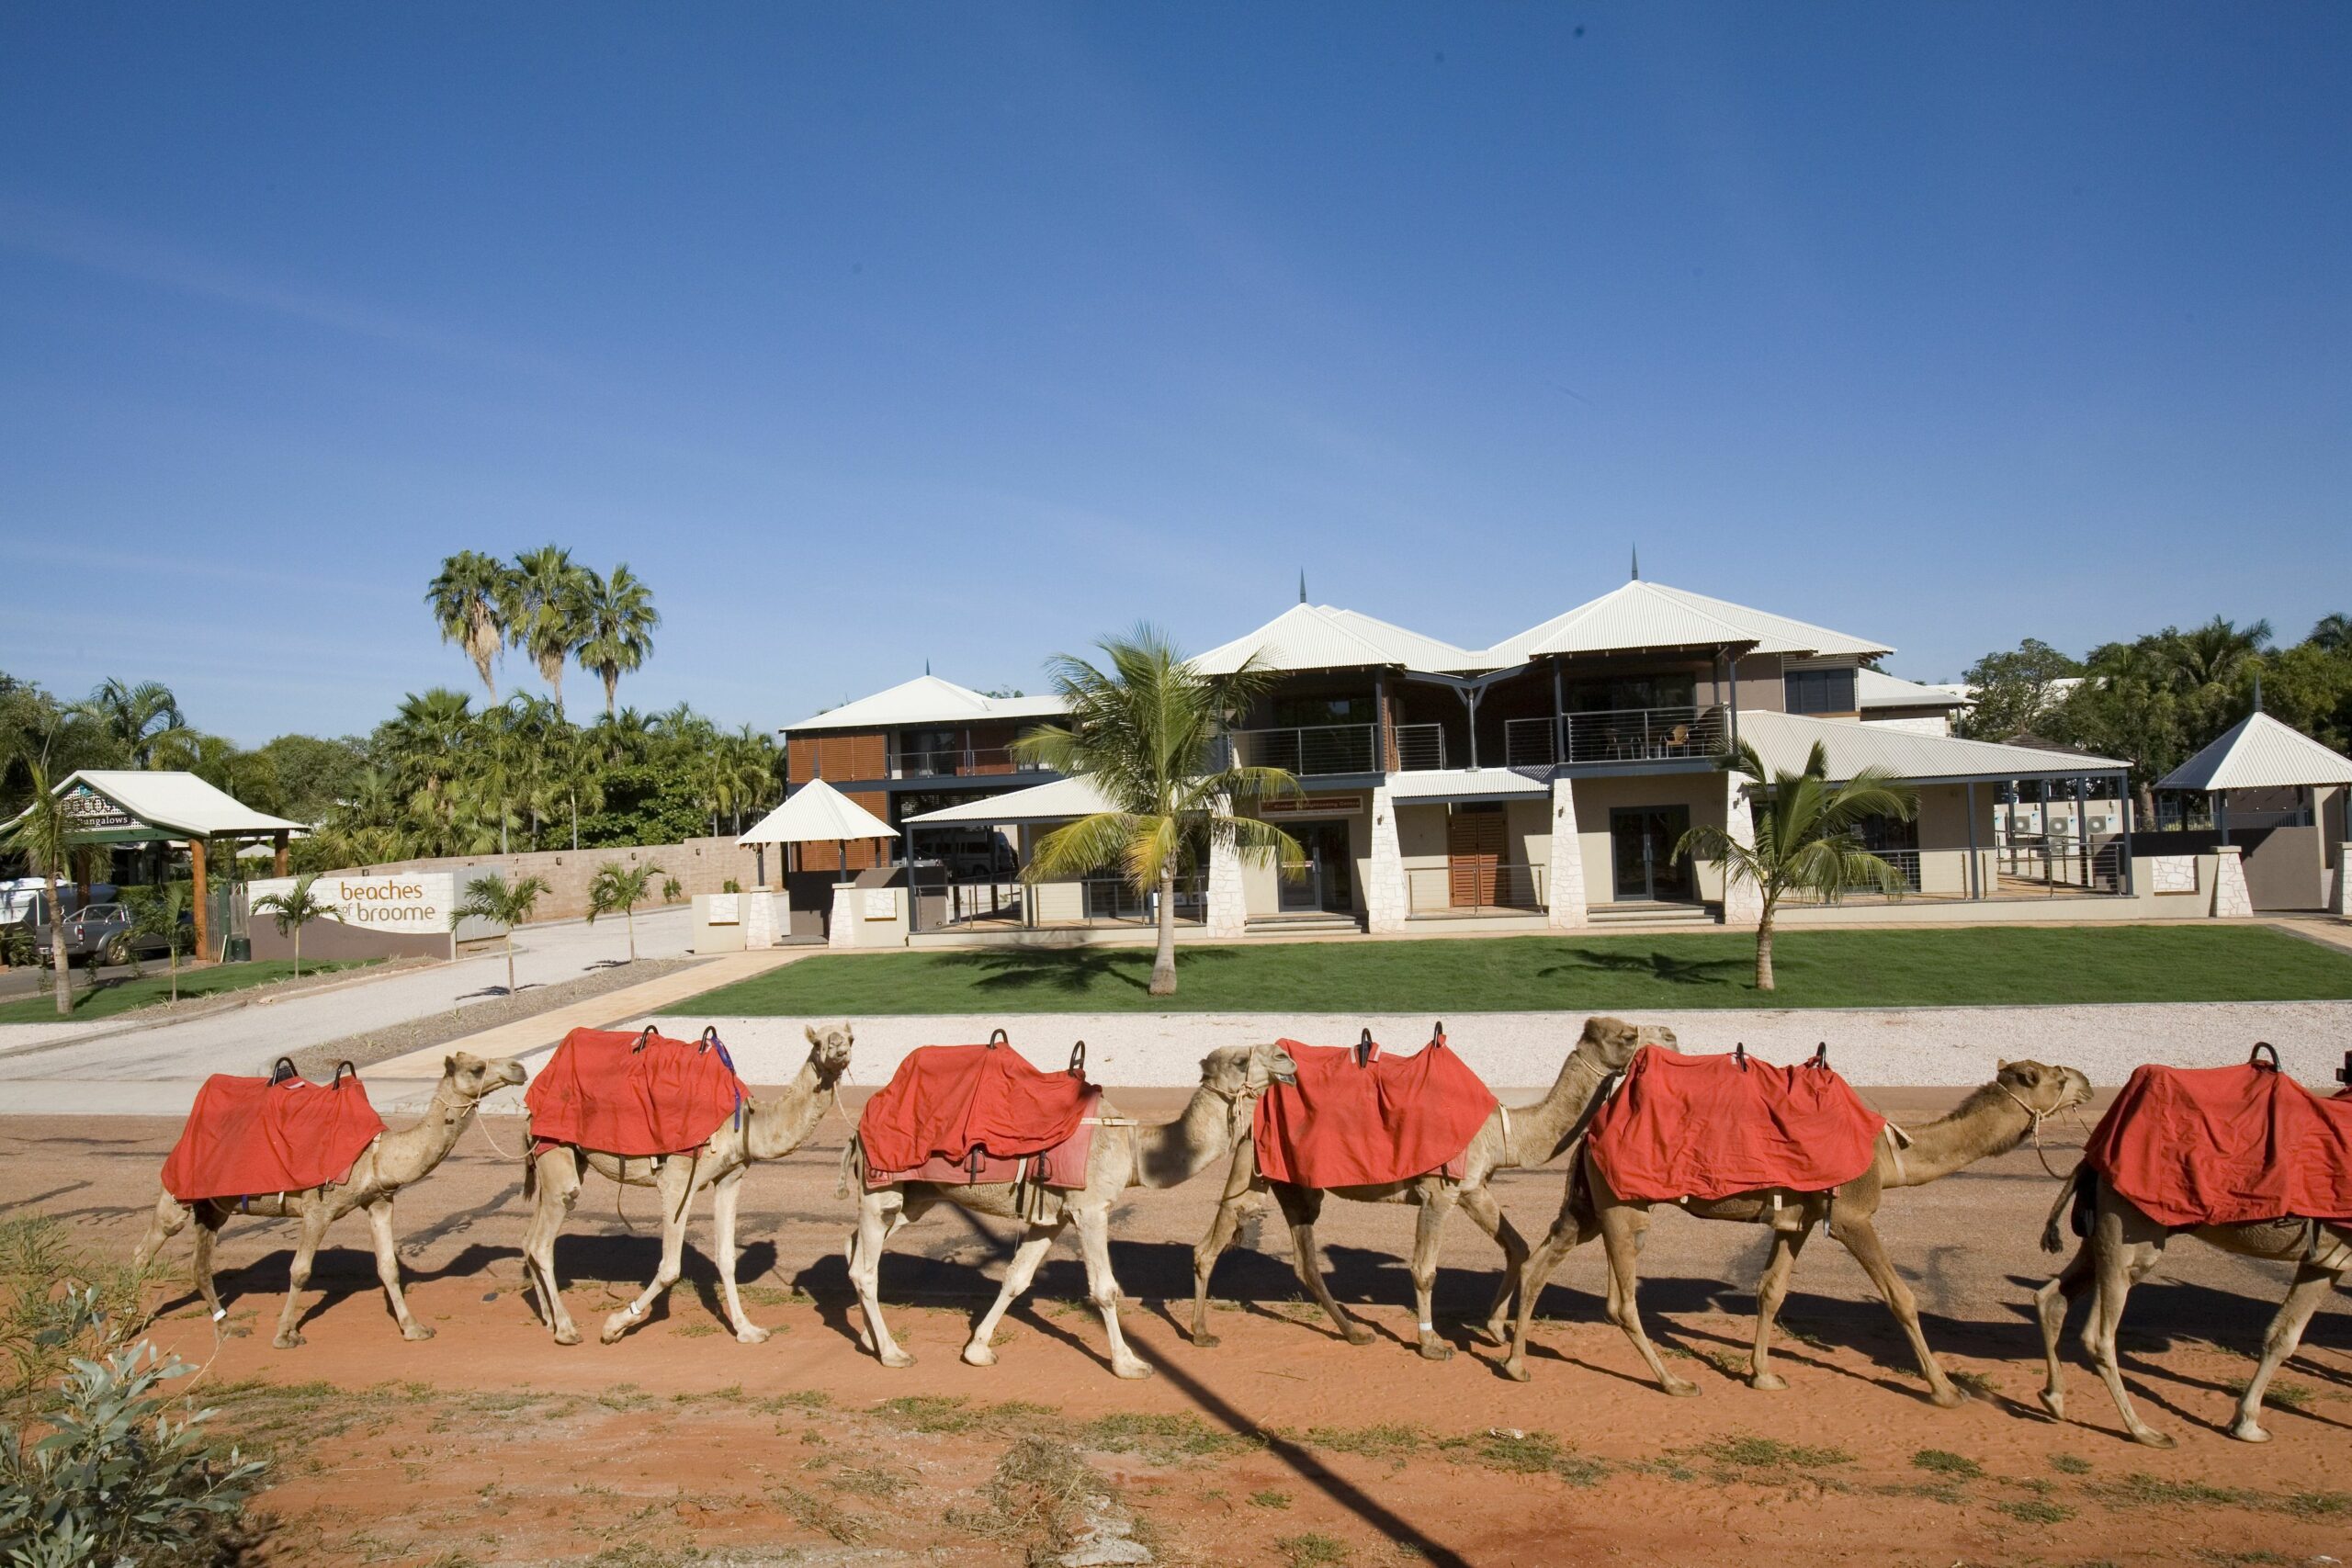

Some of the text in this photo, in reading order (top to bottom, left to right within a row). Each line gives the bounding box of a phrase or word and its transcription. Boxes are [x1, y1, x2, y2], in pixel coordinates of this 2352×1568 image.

[340, 880, 423, 901] beaches
[342, 902, 435, 922] of broome
